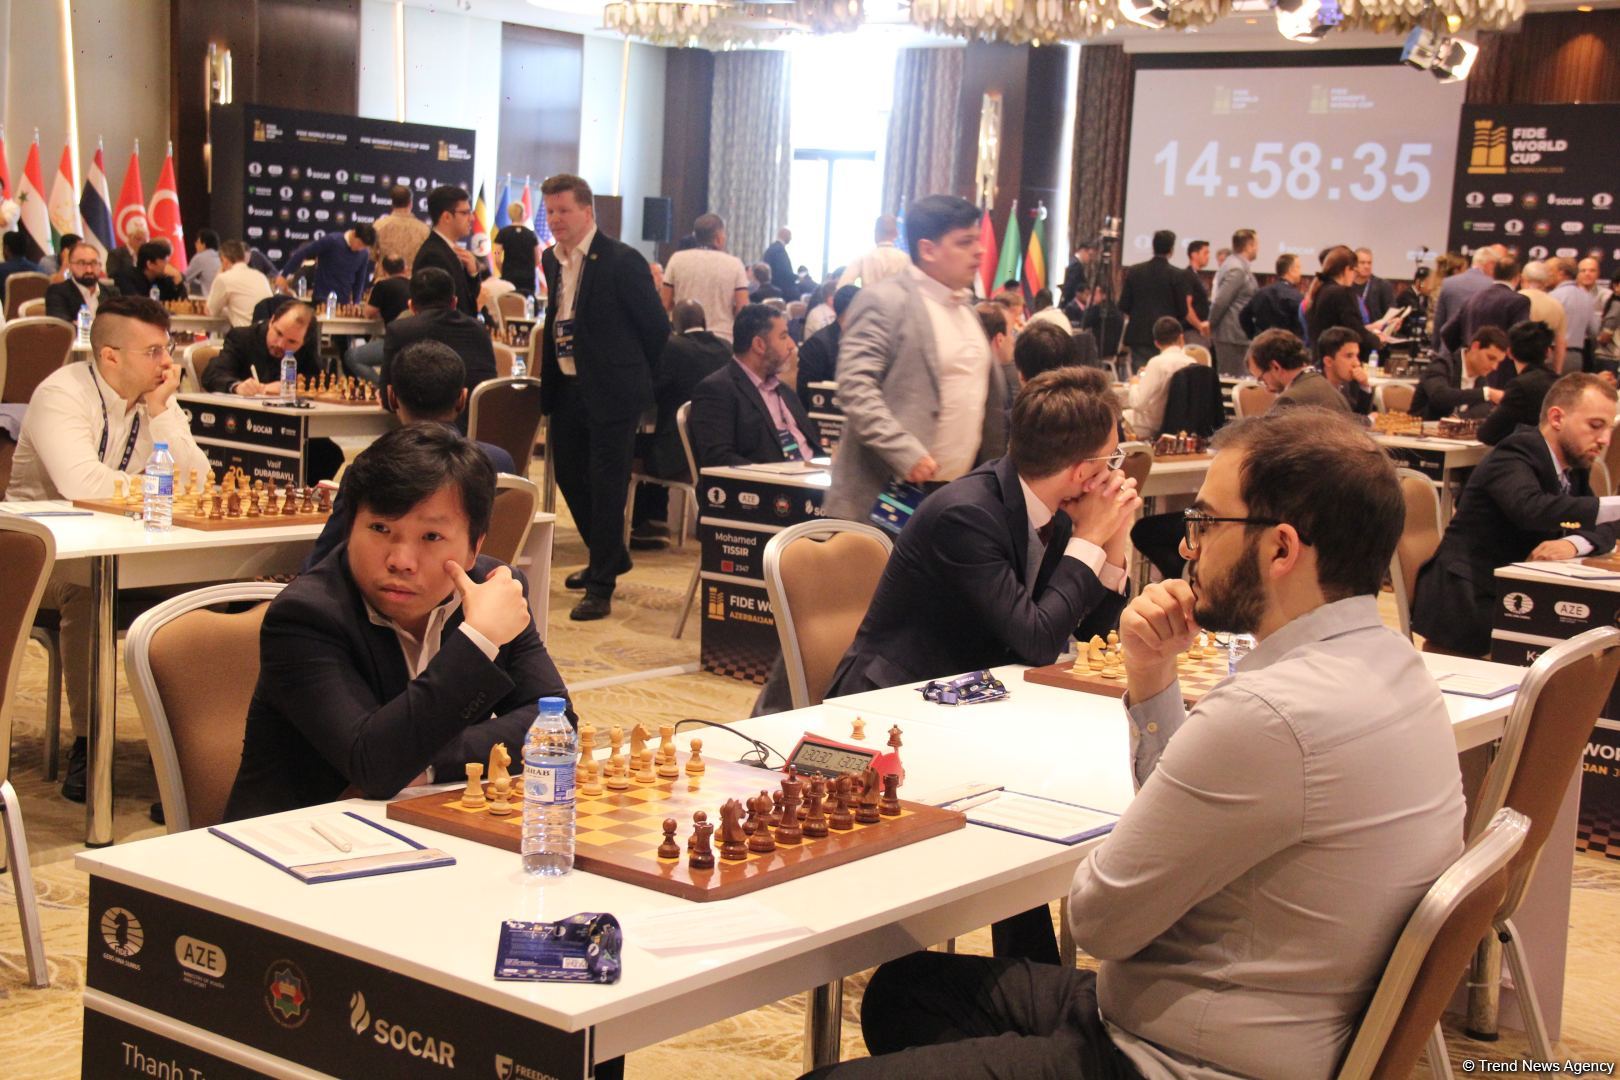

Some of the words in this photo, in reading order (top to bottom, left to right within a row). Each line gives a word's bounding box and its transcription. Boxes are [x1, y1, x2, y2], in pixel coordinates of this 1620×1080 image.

[1513, 128, 1547, 139] FIDE
[1512, 140, 1568, 152] WORLD
[1510, 152, 1542, 164] CUP
[1154, 140, 1432, 203] 14:58:35
[1556, 198, 1584, 206] SOCAR
[253, 424, 273, 435] SOCAR
[741, 493, 756, 504] AZE
[715, 532, 756, 546] Mohamed
[722, 544, 749, 557] TISSIR
[730, 595, 754, 610] FIDE
[1560, 604, 1582, 616] AZE
[730, 612, 774, 625] AZERBAIJAN
[184, 943, 217, 971] AZE
[374, 1018, 455, 1068] SOCAR
[122, 1042, 184, 1080] Thanh
